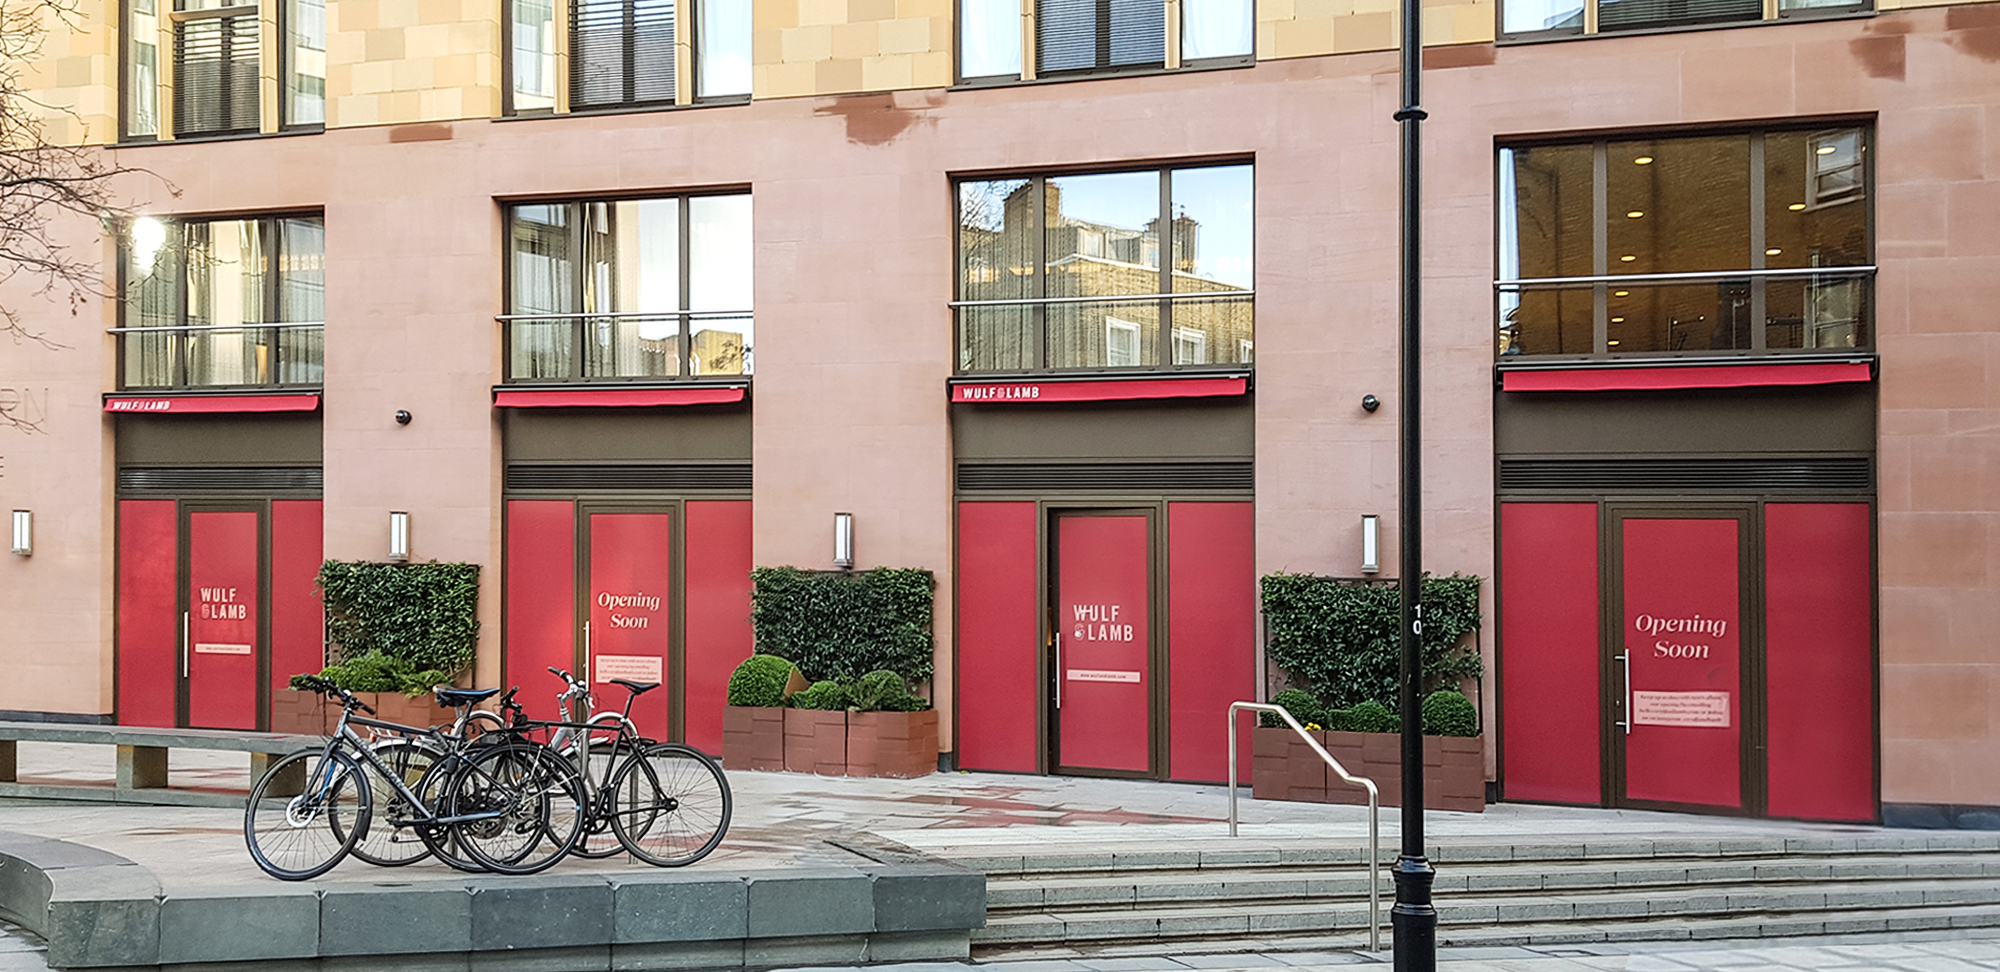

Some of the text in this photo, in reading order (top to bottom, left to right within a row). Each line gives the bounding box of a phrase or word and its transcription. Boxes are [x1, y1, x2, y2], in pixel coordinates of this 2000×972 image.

[962, 386, 1041, 399] WULF&LAMB
[200, 587, 237, 603] WULF
[598, 591, 661, 611] Opening
[610, 613, 648, 629] Soon
[1073, 604, 1120, 622] WULF
[1635, 614, 1727, 638] Opening
[1654, 640, 1710, 659] Soon
